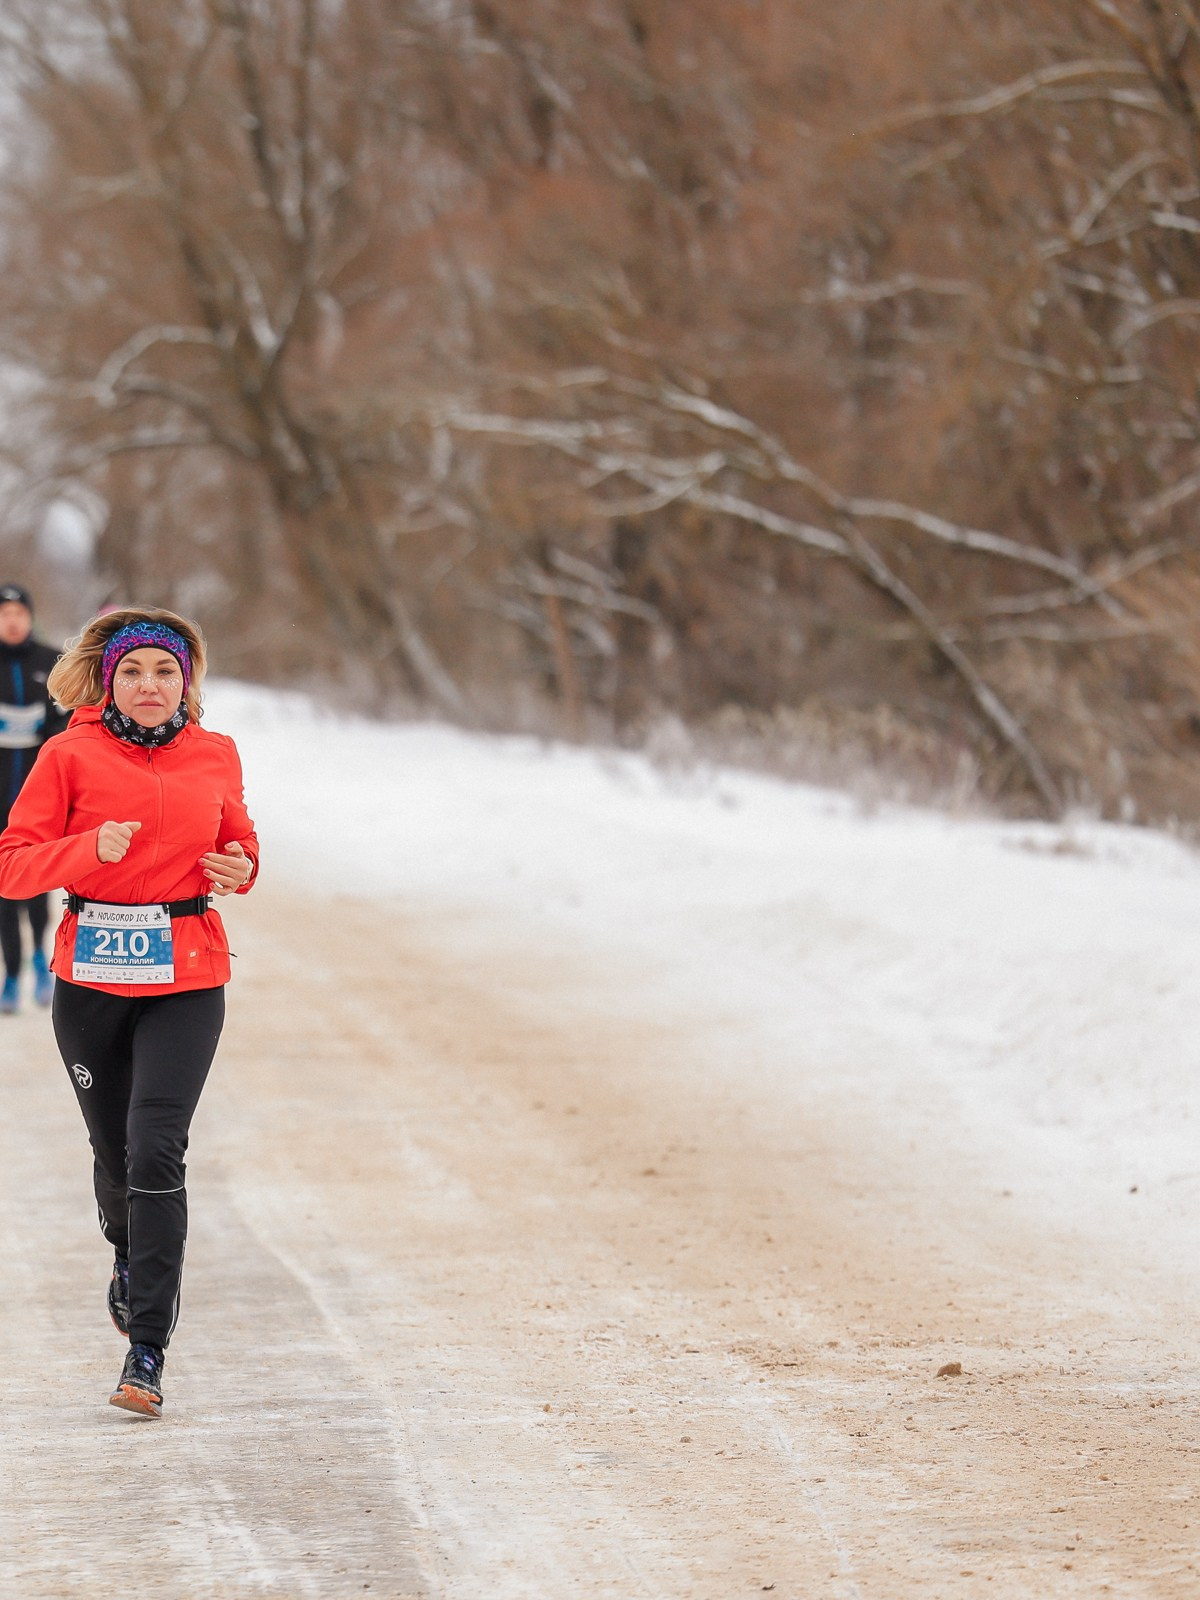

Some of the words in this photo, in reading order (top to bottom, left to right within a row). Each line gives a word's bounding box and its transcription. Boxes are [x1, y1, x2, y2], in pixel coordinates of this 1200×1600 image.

[97, 911, 134, 922] NOVGOROD
[136, 913, 148, 922] ICE
[94, 929, 150, 957] 210
[90, 956, 127, 965] КОНОНОВА
